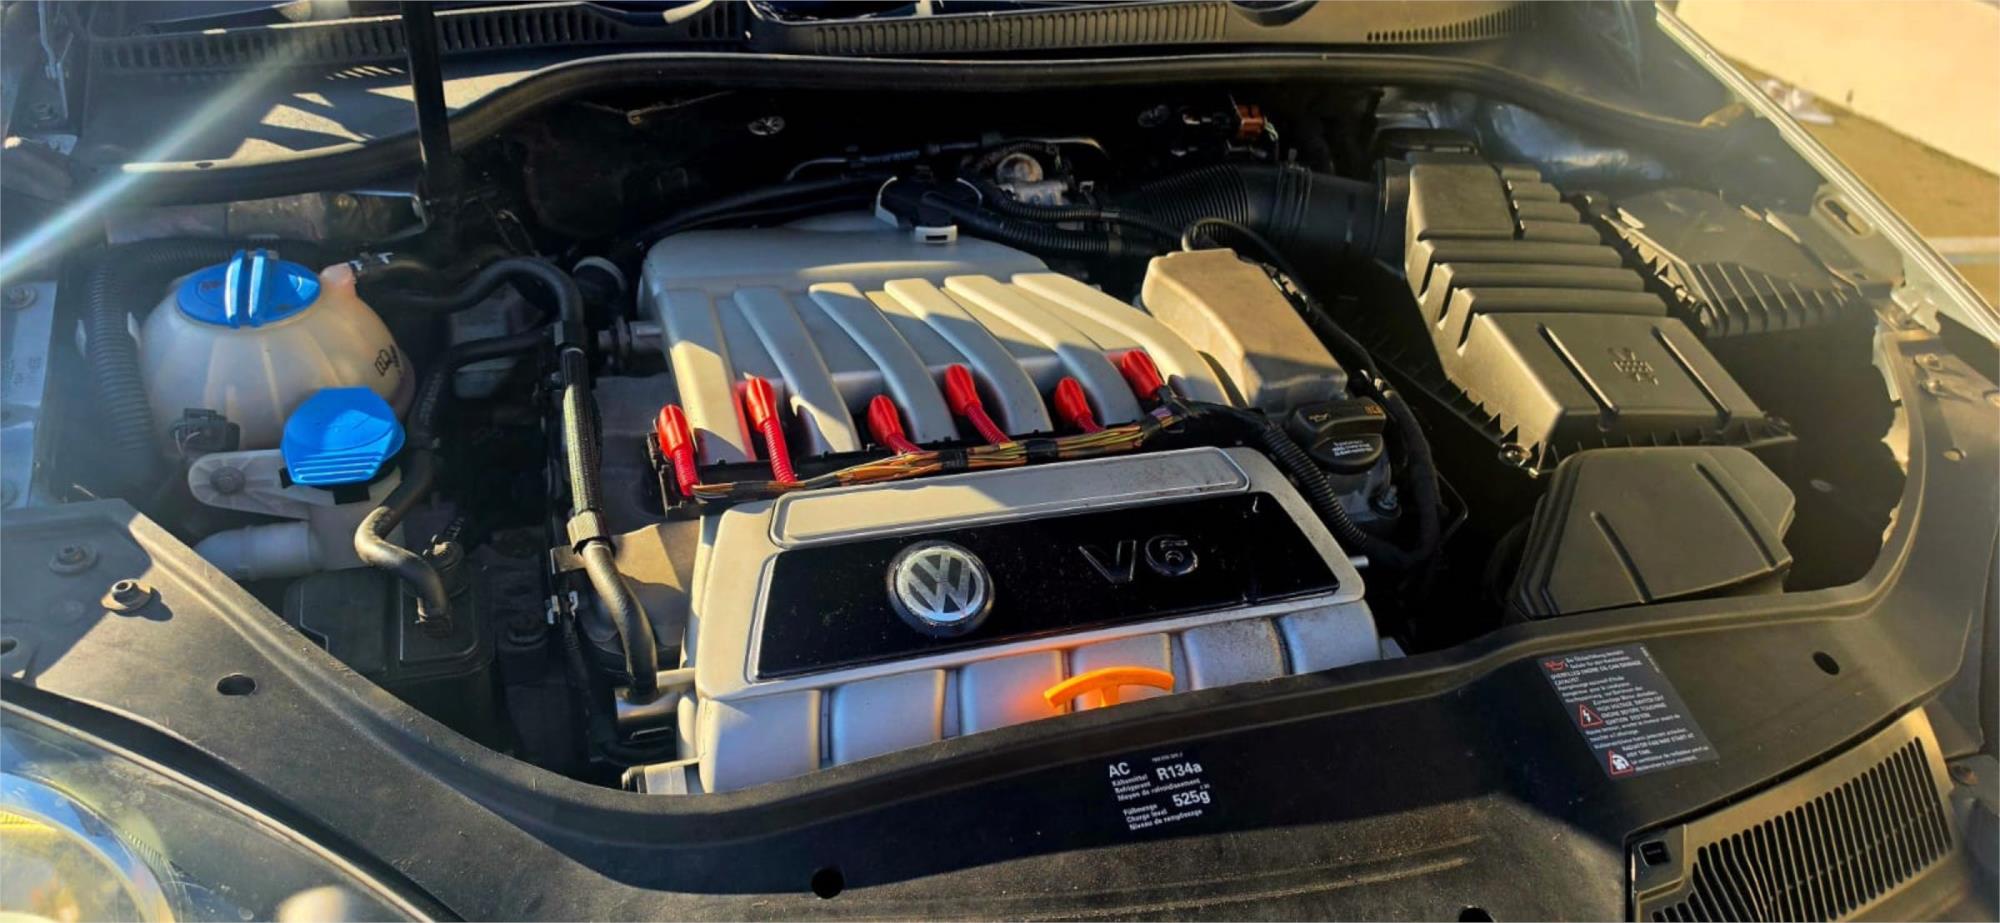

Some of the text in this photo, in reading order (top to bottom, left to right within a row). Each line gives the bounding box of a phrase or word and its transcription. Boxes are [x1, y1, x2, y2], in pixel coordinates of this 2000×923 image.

[1078, 535, 1199, 583] V6
[1109, 762, 1130, 778] AC
[1156, 762, 1202, 780] R134a
[1172, 790, 1211, 807] 525g
